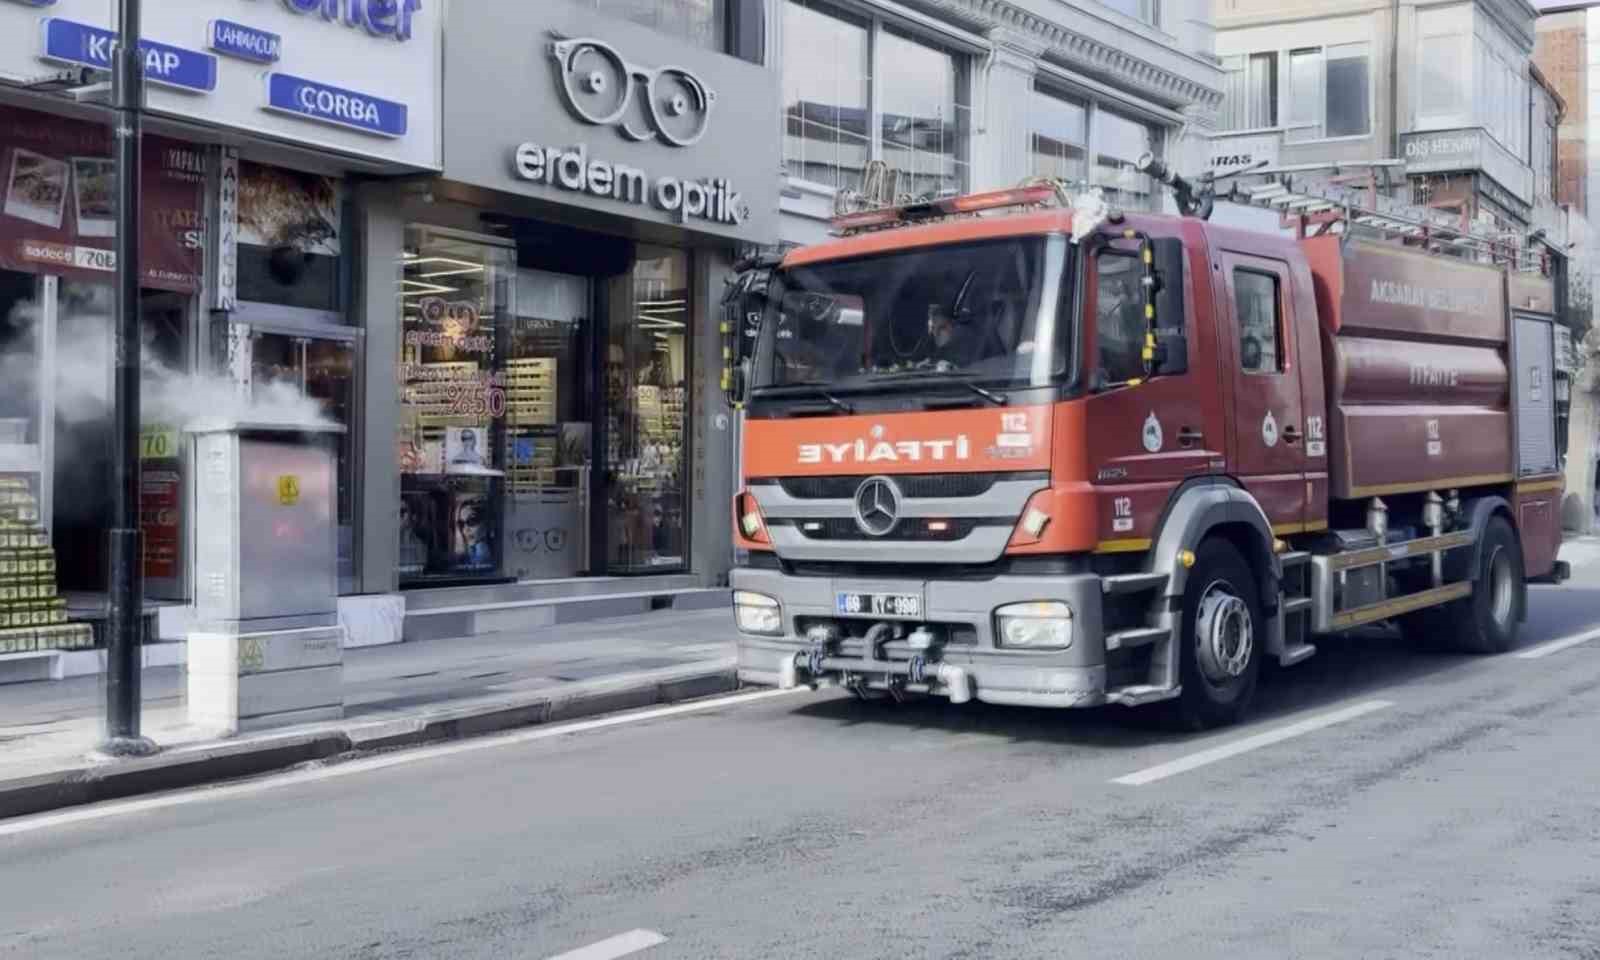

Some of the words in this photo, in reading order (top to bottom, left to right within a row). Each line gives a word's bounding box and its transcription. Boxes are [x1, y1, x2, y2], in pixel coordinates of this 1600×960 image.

[216, 24, 280, 57] LAHMACUN
[299, 86, 382, 126] ÇORBA
[515, 142, 647, 204] erdem
[657, 176, 742, 225] optik
[1307, 416, 1323, 440] 112
[1114, 496, 1132, 517] 112
